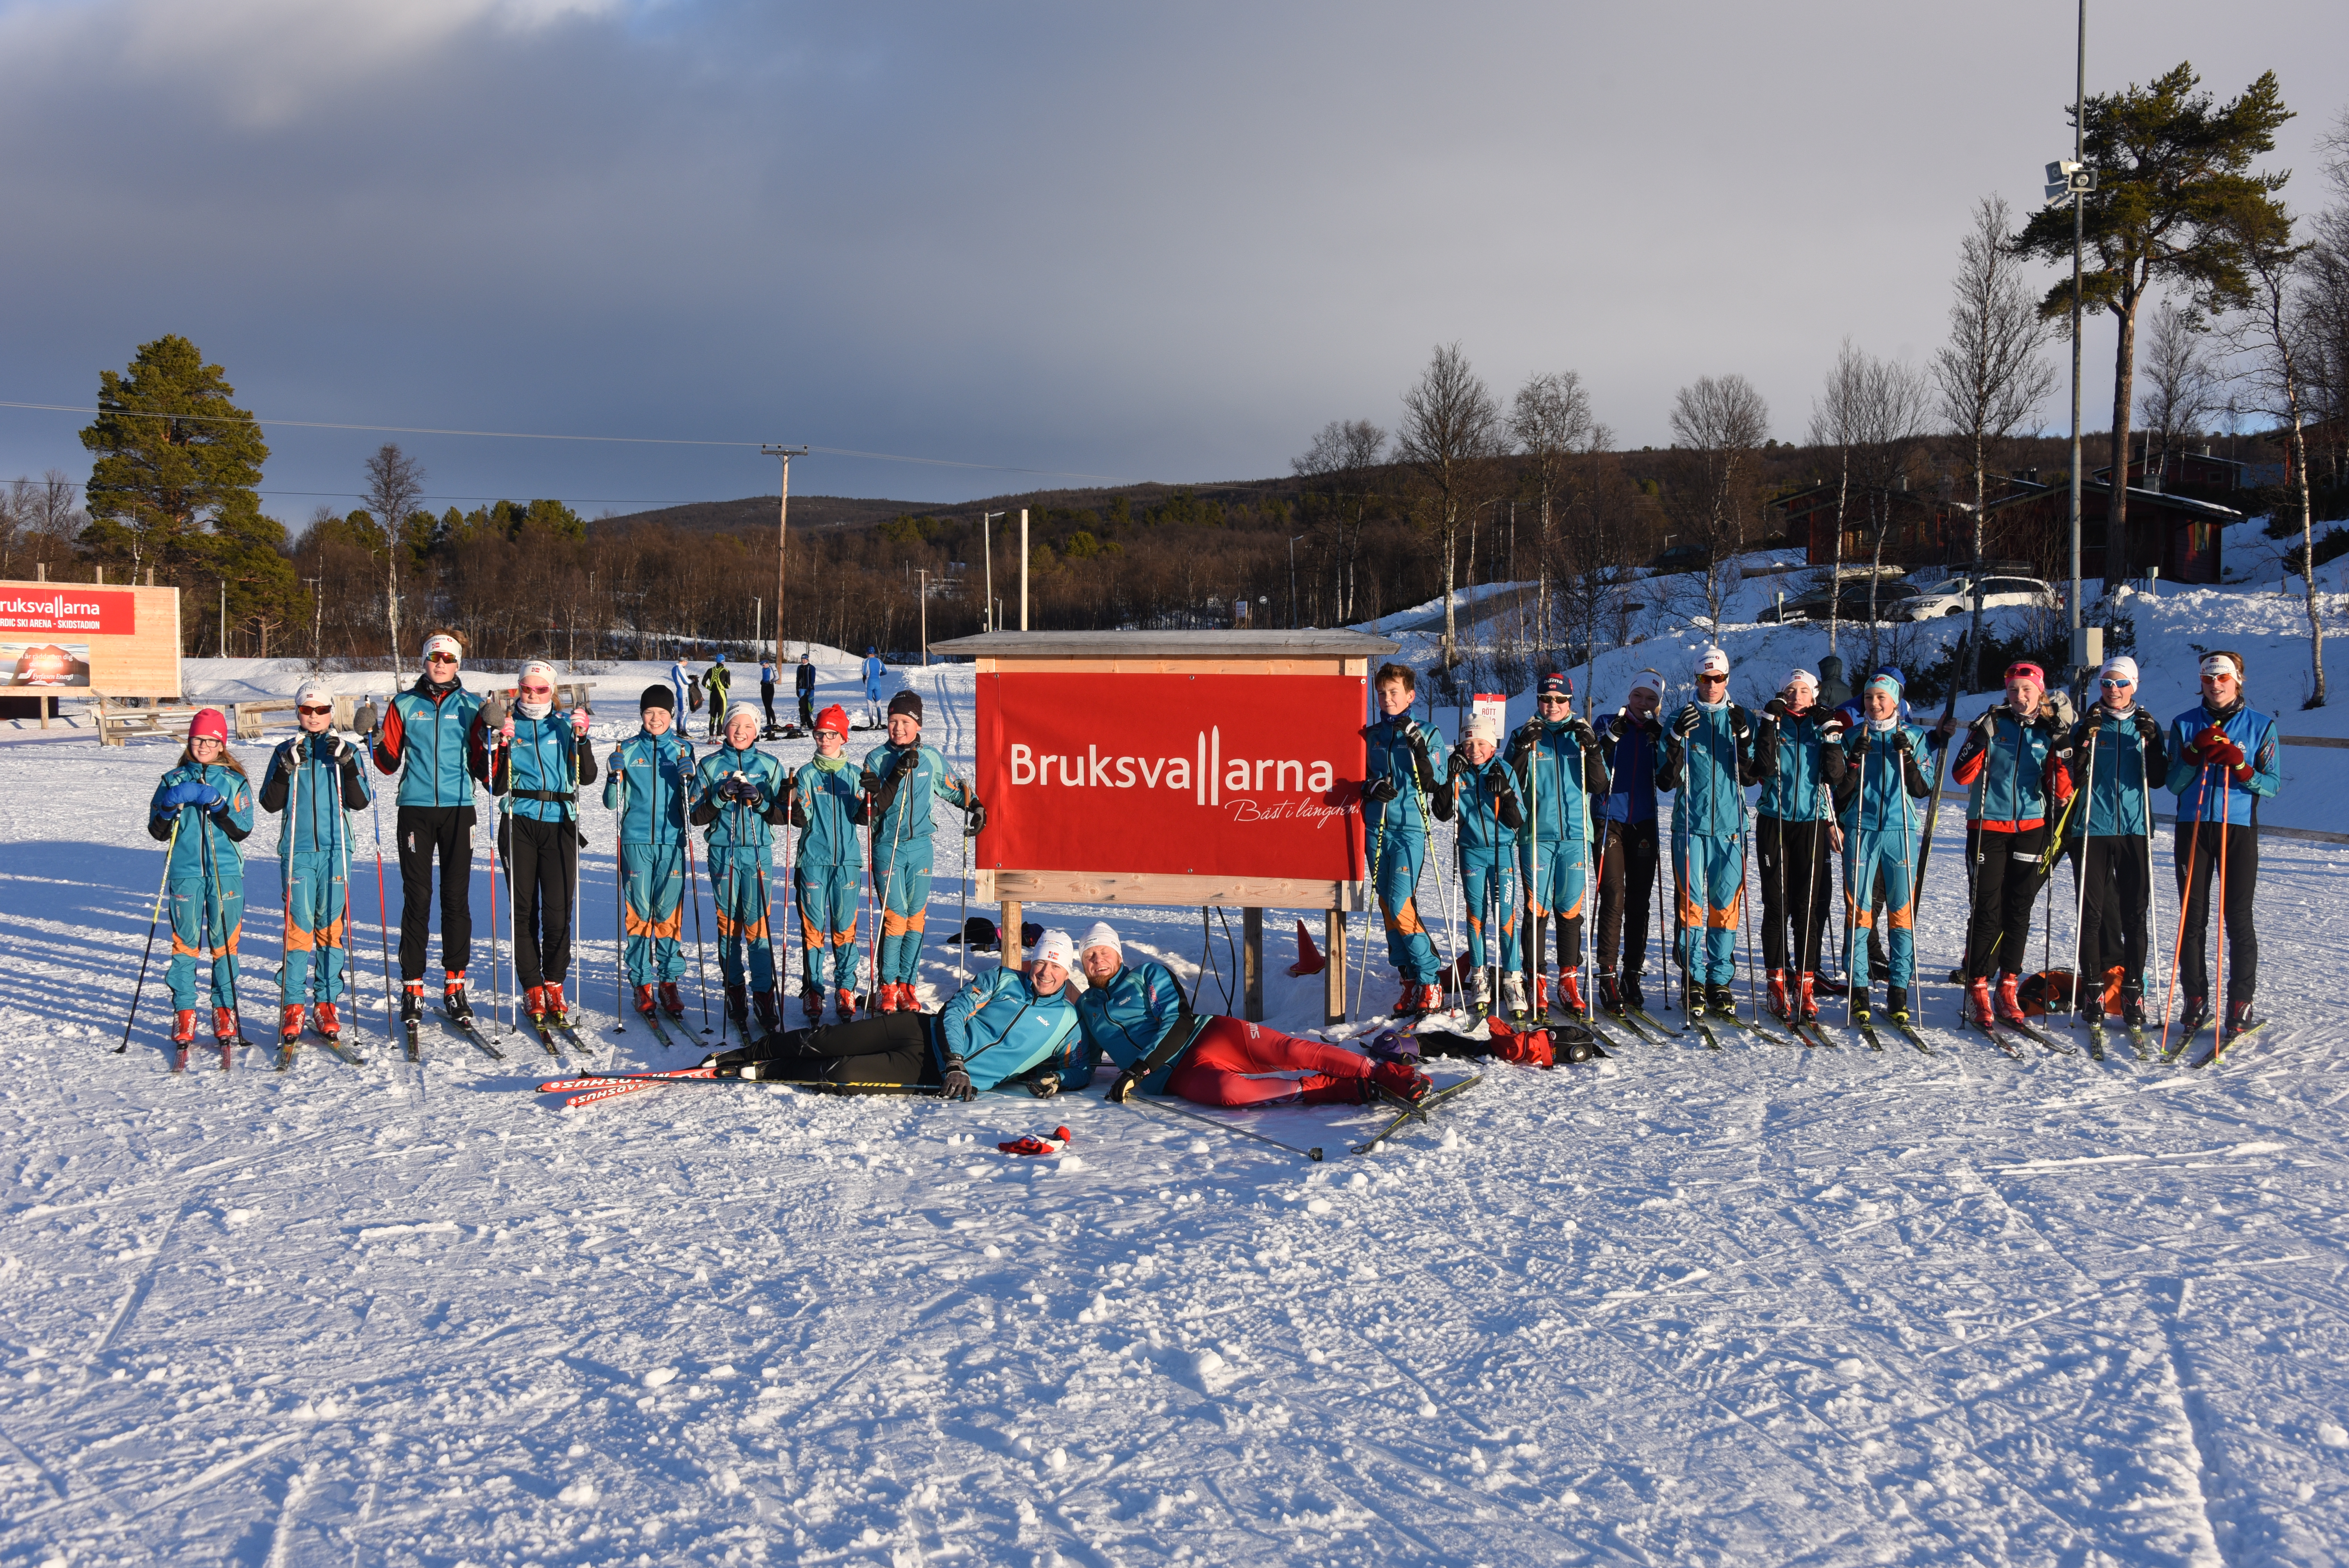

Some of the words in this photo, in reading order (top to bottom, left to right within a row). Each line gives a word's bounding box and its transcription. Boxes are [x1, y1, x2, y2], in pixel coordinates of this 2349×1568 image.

[17, 619, 28, 627] SKI
[30, 619, 52, 628] ARENA
[58, 620, 100, 629] SKIDSTADION
[1482, 707, 1496, 715] RÖTT
[1011, 725, 1333, 806] Bruksvallarna
[1224, 799, 1288, 821] Bäst
